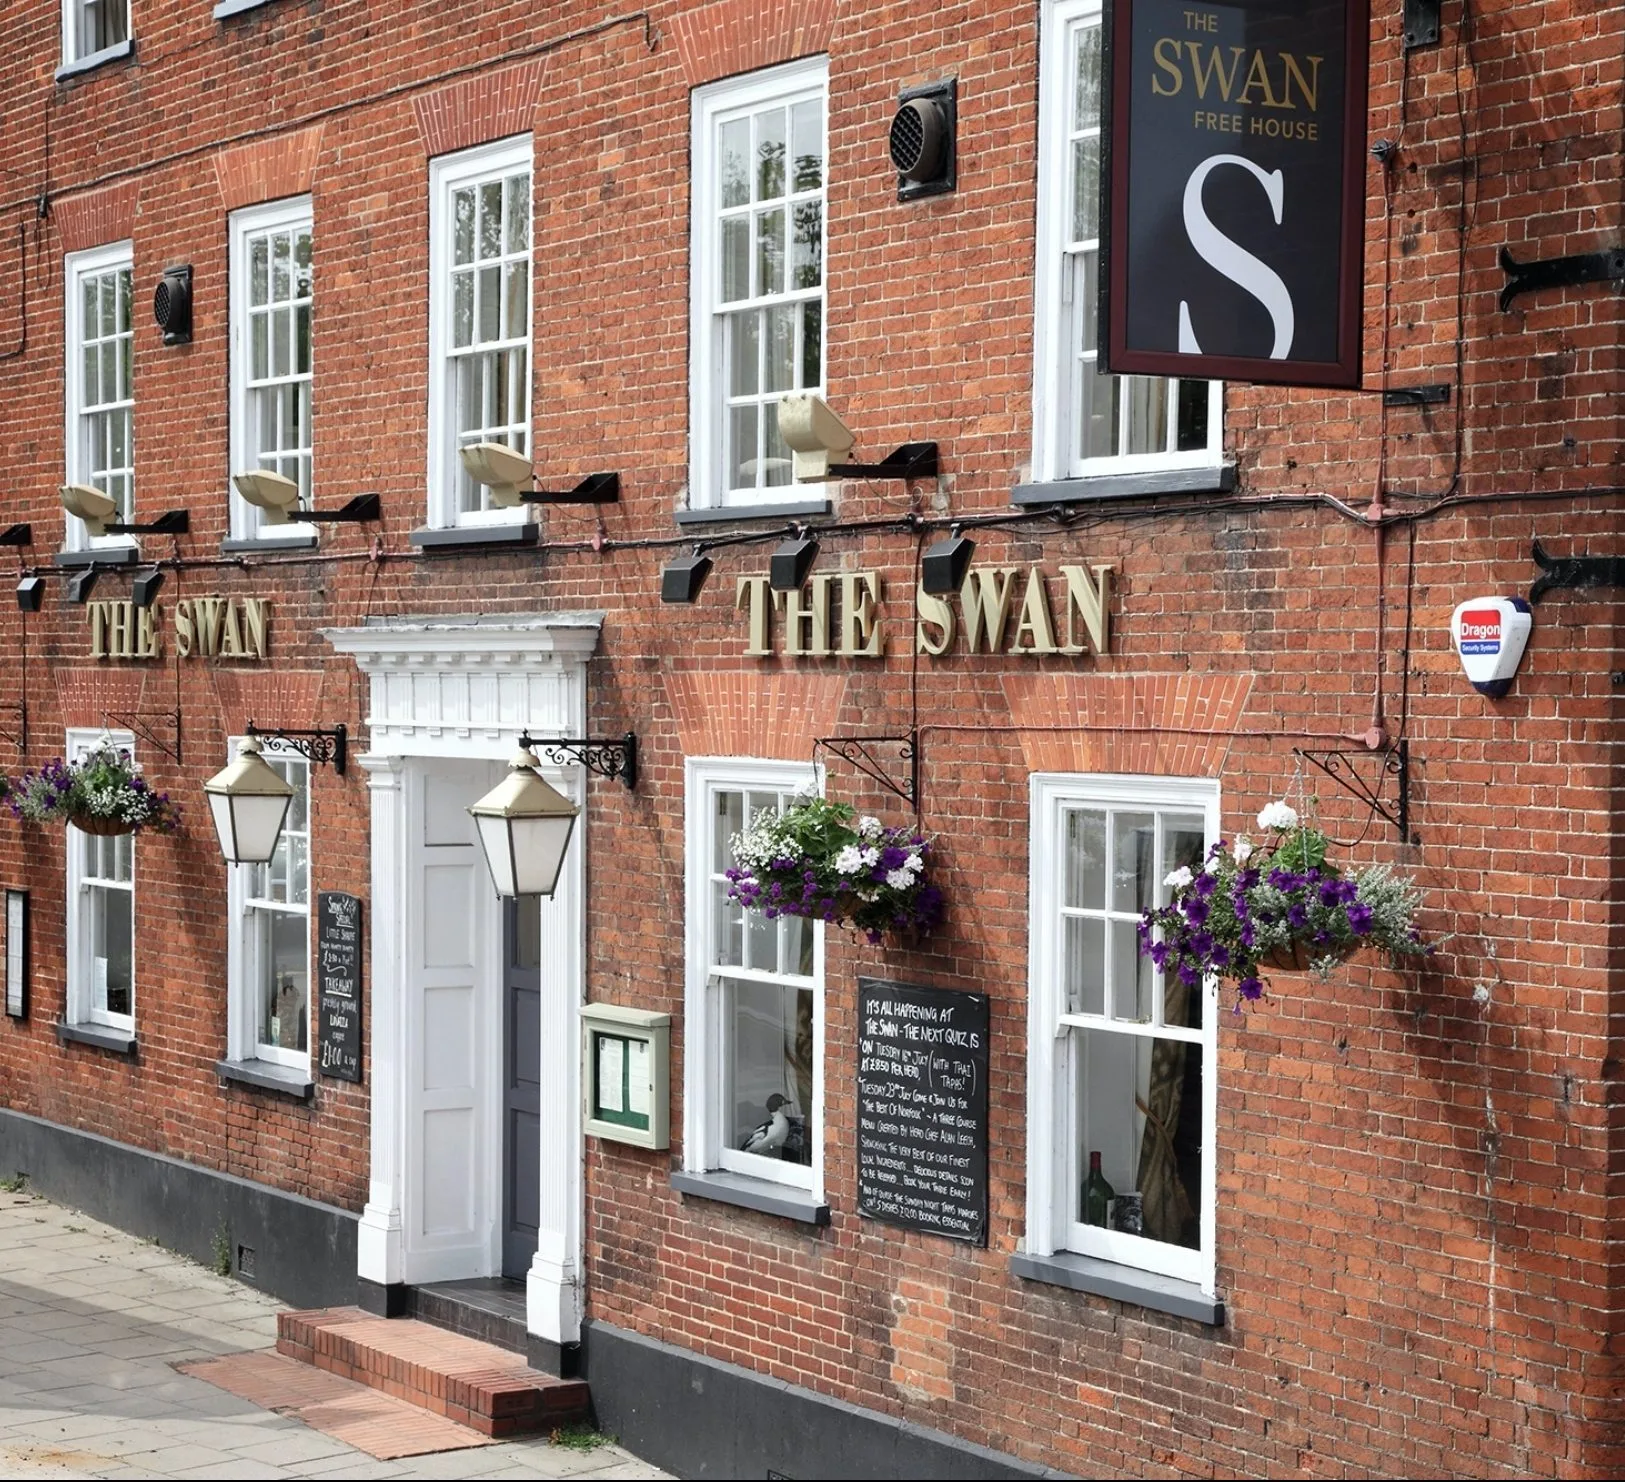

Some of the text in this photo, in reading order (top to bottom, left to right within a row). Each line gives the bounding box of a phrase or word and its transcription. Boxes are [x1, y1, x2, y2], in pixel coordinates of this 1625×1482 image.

[1183, 11, 1219, 33] THE
[1152, 37, 1324, 112] SWAN
[1194, 111, 1318, 141] FREE HOUSE
[1178, 154, 1295, 360] S
[736, 563, 1117, 656] THE SWAN
[86, 597, 271, 658] THE SWAN
[1461, 622, 1500, 638] Dragon
[1462, 644, 1498, 652] Security Systems
[866, 1000, 954, 1022] IT'S ALL HAPPENING AT
[865, 1018, 878, 1036] THE
[879, 1019, 898, 1038] SWAN
[903, 1023, 919, 1041] THE
[920, 1026, 944, 1043] NEXT
[945, 1028, 968, 1048] QUIZ
[970, 1033, 979, 1048] IS
[862, 1040, 874, 1054] ON
[876, 1042, 900, 1061] TUESDAY
[912, 1051, 928, 1065] JULY
[861, 1057, 869, 1072] AT
[891, 1062, 904, 1076] PER
[889, 1103, 897, 1115] OF
[948, 1096, 956, 1108] US
